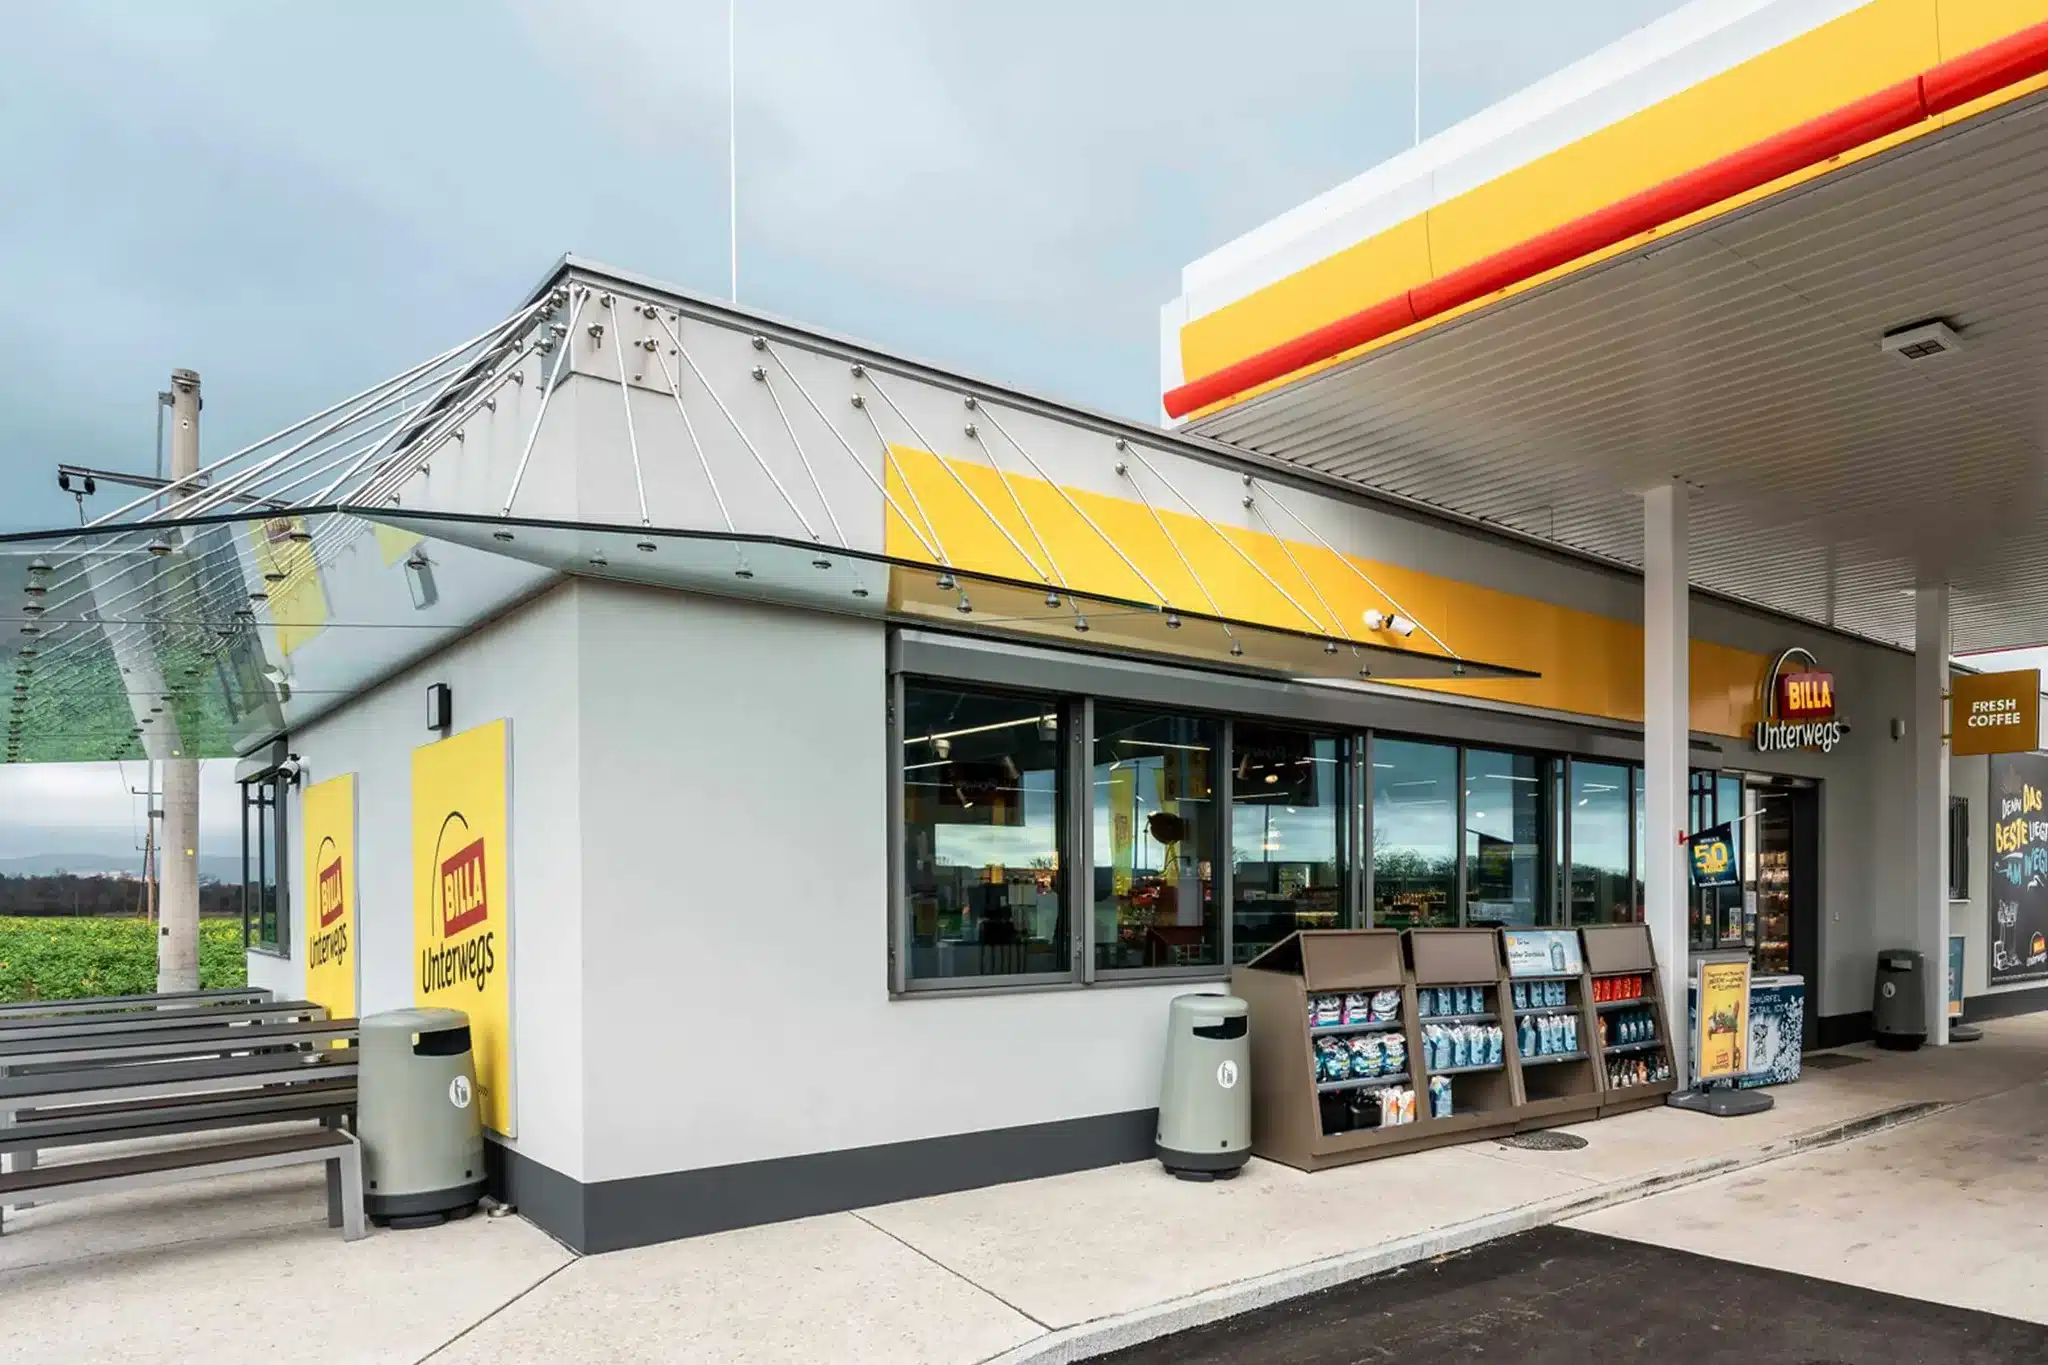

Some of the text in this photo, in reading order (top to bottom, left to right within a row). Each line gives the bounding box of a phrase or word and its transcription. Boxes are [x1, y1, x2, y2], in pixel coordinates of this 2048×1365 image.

[1788, 681, 1832, 711] BILLA
[1971, 699, 2017, 713] FRESH
[1757, 719, 1841, 753] Unterwegs
[1967, 712, 2021, 728] COFFEE
[2023, 783, 2043, 814] DAS
[1995, 817, 2029, 854] BESTE
[1694, 842, 1729, 869] 50
[320, 868, 341, 917] BILLA
[444, 855, 485, 923] BILLA
[309, 921, 348, 970] Unterwegs
[422, 931, 495, 994] Unterwegs
